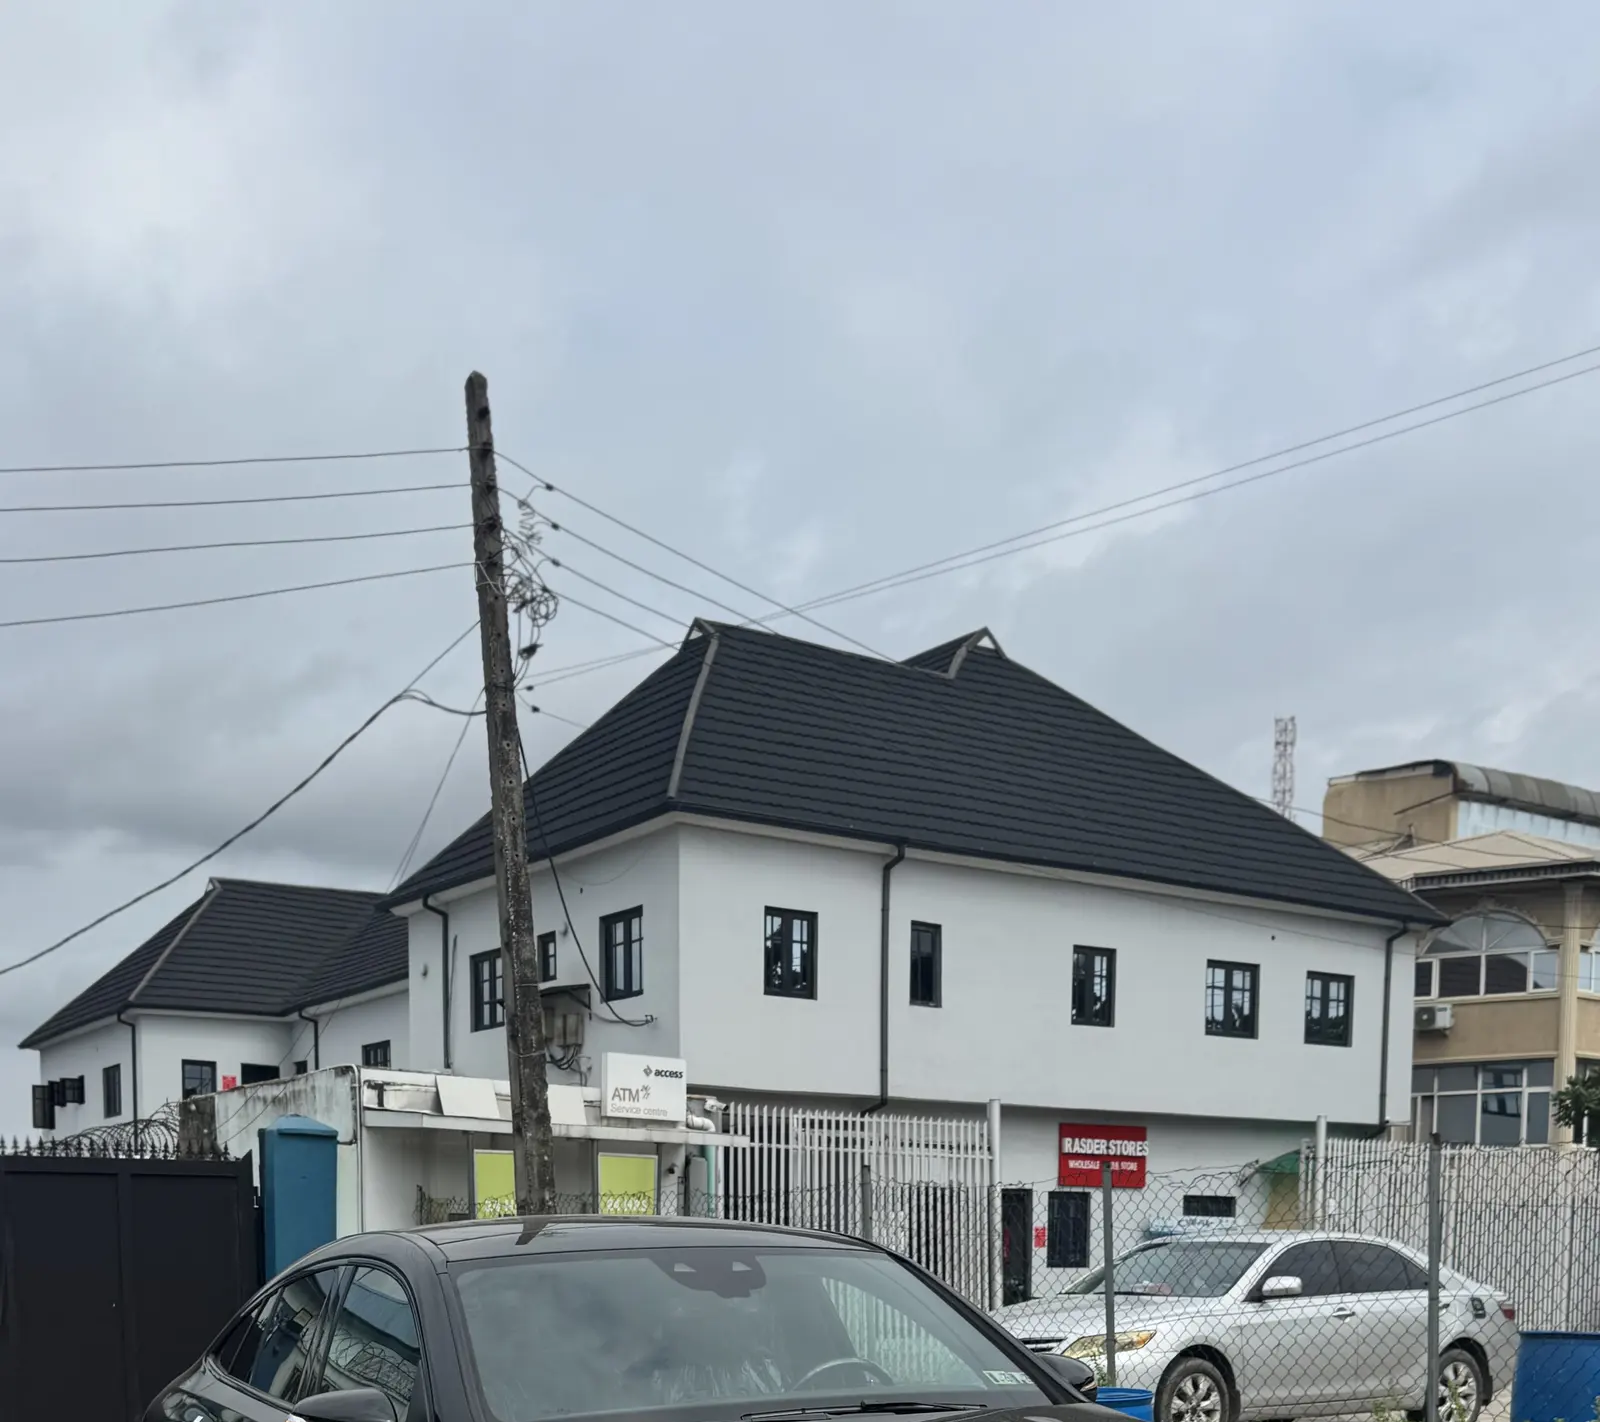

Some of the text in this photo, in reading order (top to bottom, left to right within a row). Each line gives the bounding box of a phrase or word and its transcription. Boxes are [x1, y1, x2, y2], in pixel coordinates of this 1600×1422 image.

[654, 1068, 684, 1079] access
[611, 1087, 640, 1103] ATM
[610, 1103, 641, 1115] Service
[1063, 1137, 1149, 1156] RASDER STORES
[1068, 1160, 1100, 1170] WHOLESALE
